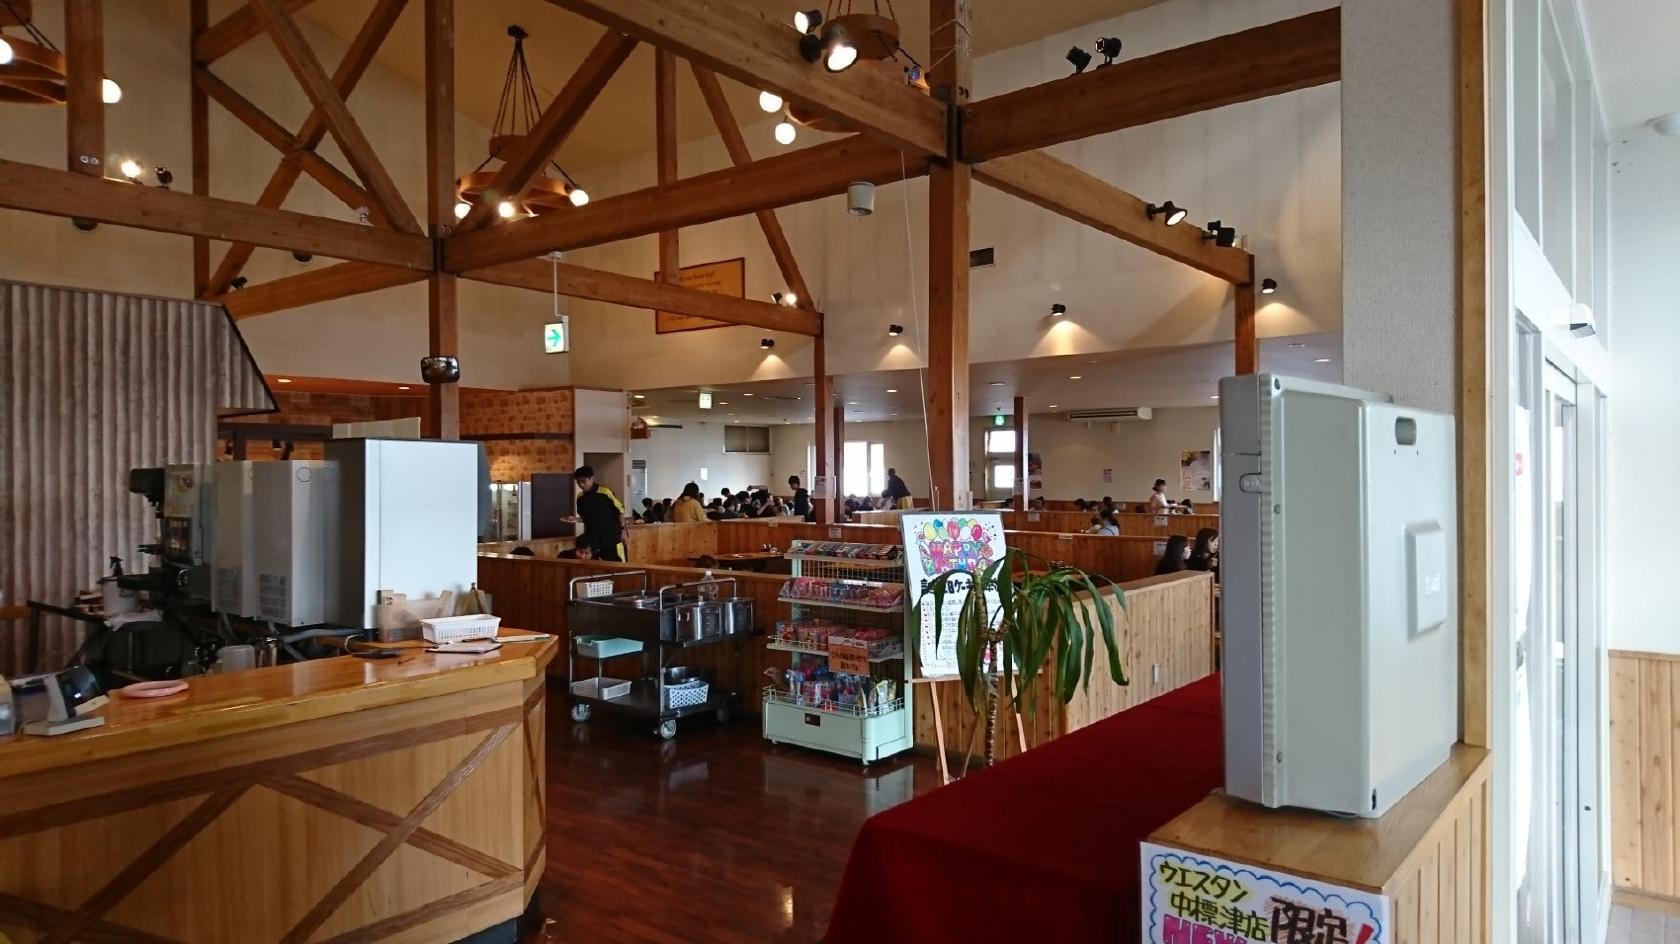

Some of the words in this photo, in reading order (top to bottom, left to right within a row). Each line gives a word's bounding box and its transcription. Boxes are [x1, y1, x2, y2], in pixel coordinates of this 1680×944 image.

[1160, 860, 1249, 904] ウエスタン
[1170, 891, 1270, 943] 中標津店
